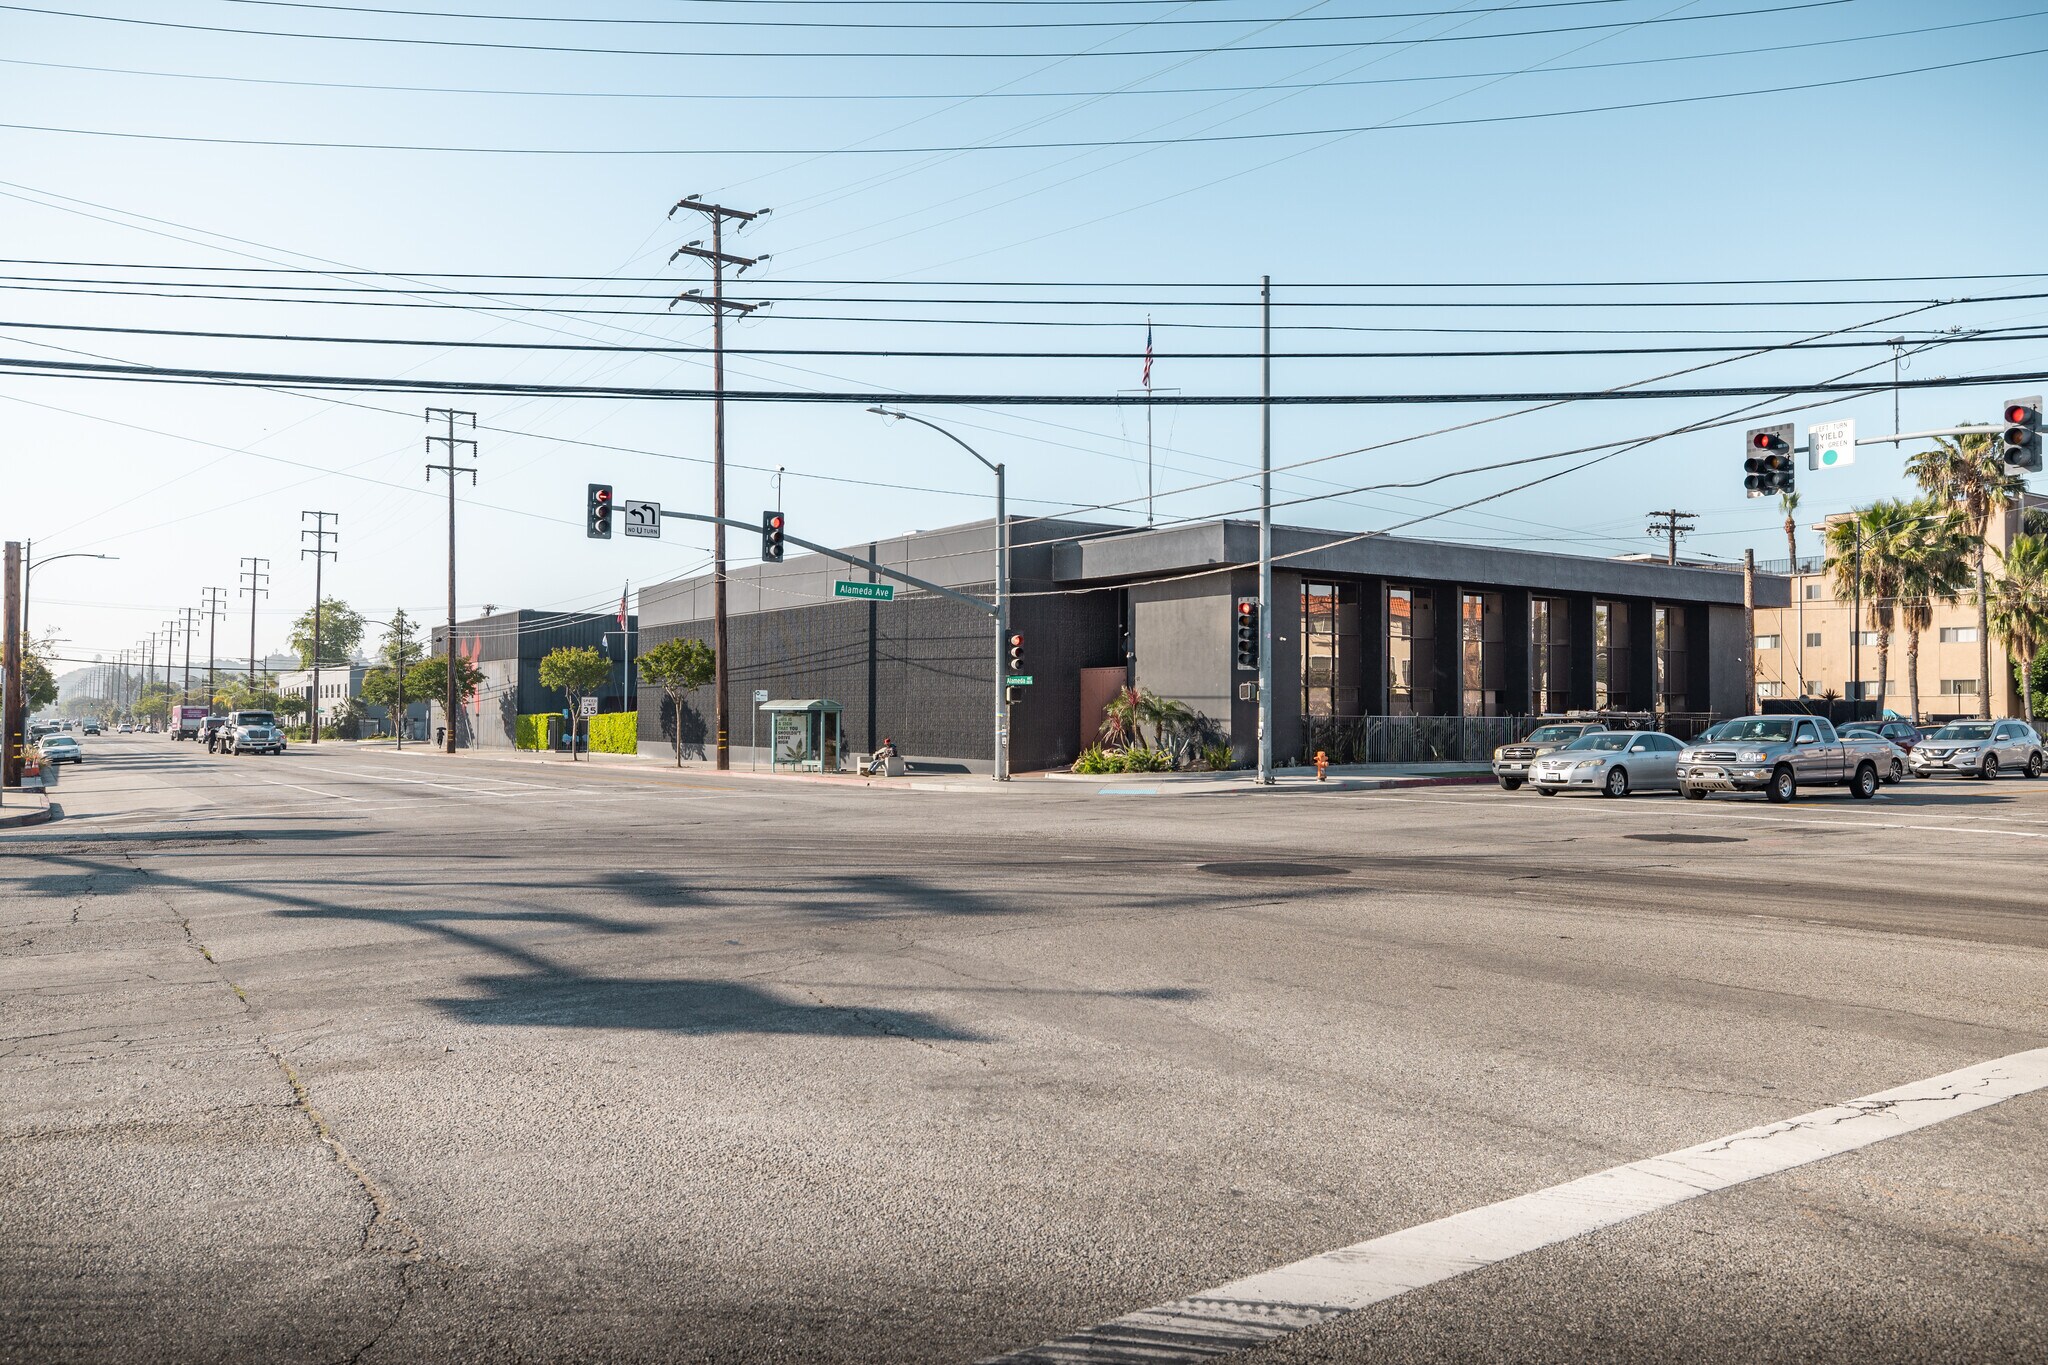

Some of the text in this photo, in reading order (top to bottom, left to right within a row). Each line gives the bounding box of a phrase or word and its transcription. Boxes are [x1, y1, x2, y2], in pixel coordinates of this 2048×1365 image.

[1820, 431, 1843, 440] YIELD
[636, 526, 643, 534] U
[840, 584, 889, 596] Alameda Ave
[583, 706, 596, 714] 35
